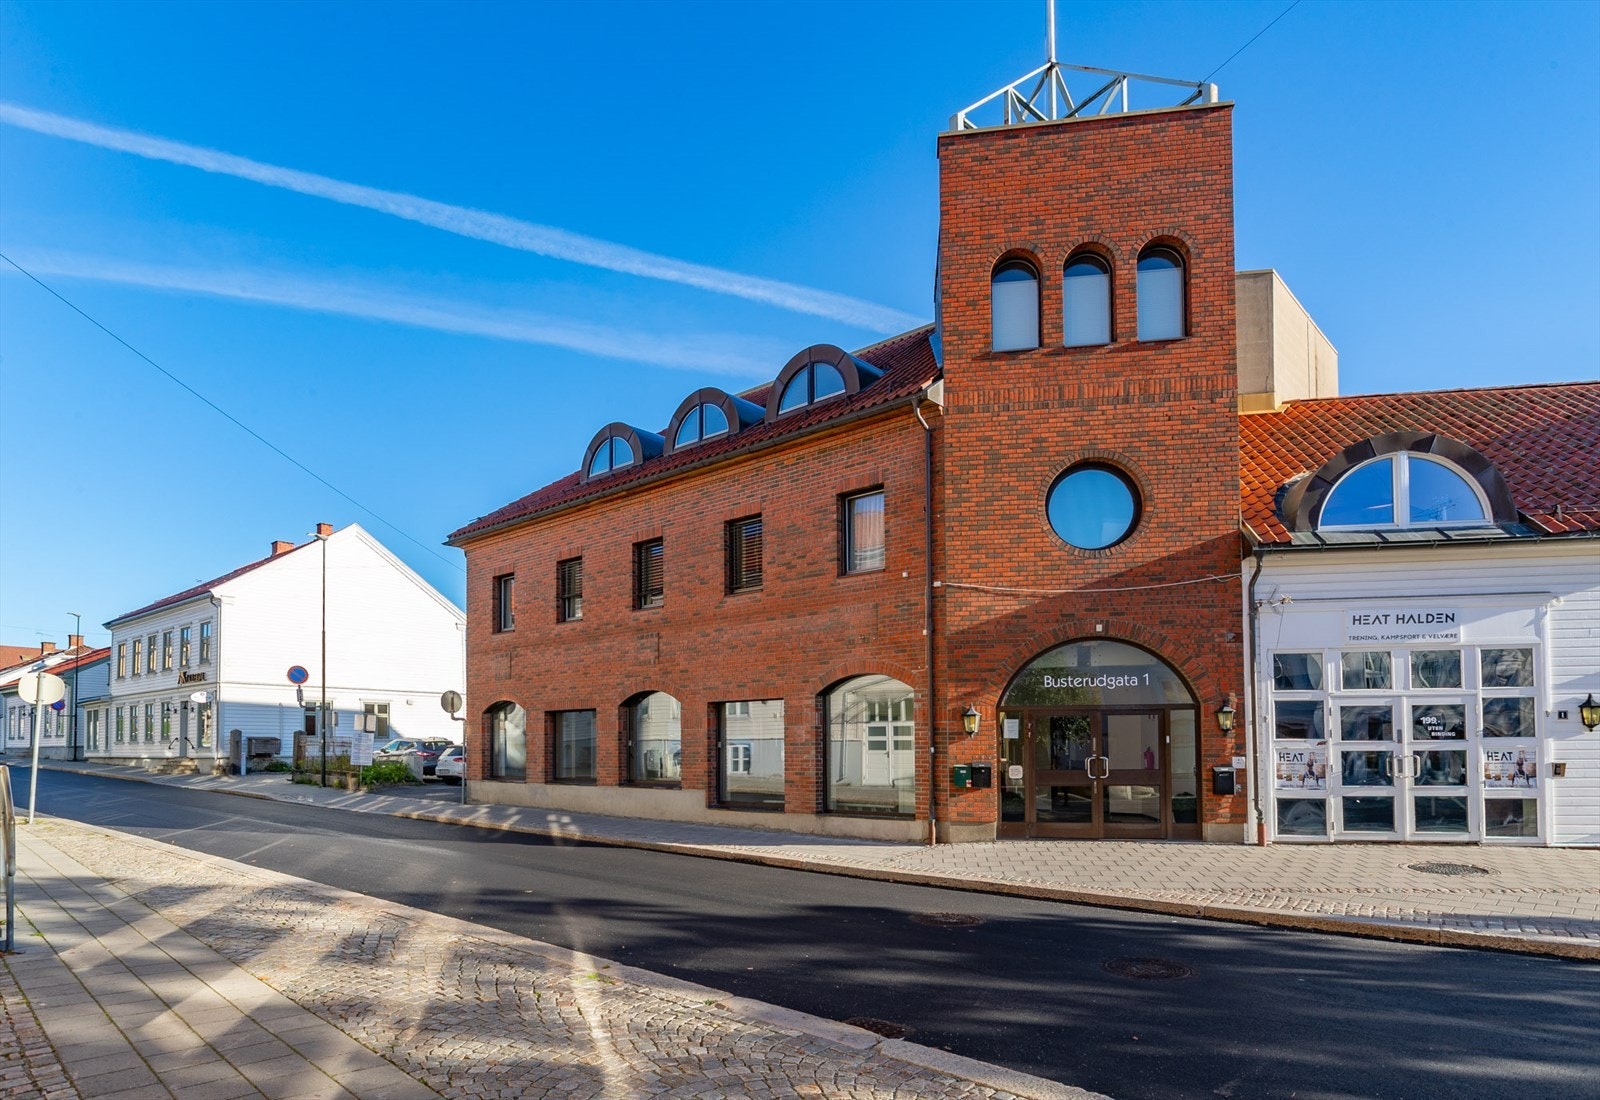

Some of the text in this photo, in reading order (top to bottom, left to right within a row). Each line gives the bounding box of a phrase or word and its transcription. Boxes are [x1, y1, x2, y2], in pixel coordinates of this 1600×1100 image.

[1352, 612, 1455, 625] HEAT HALDEN
[1044, 673, 1149, 690] Busterudgata 1
[1279, 752, 1304, 762] HEAT
[1486, 751, 1513, 761] HEAT
